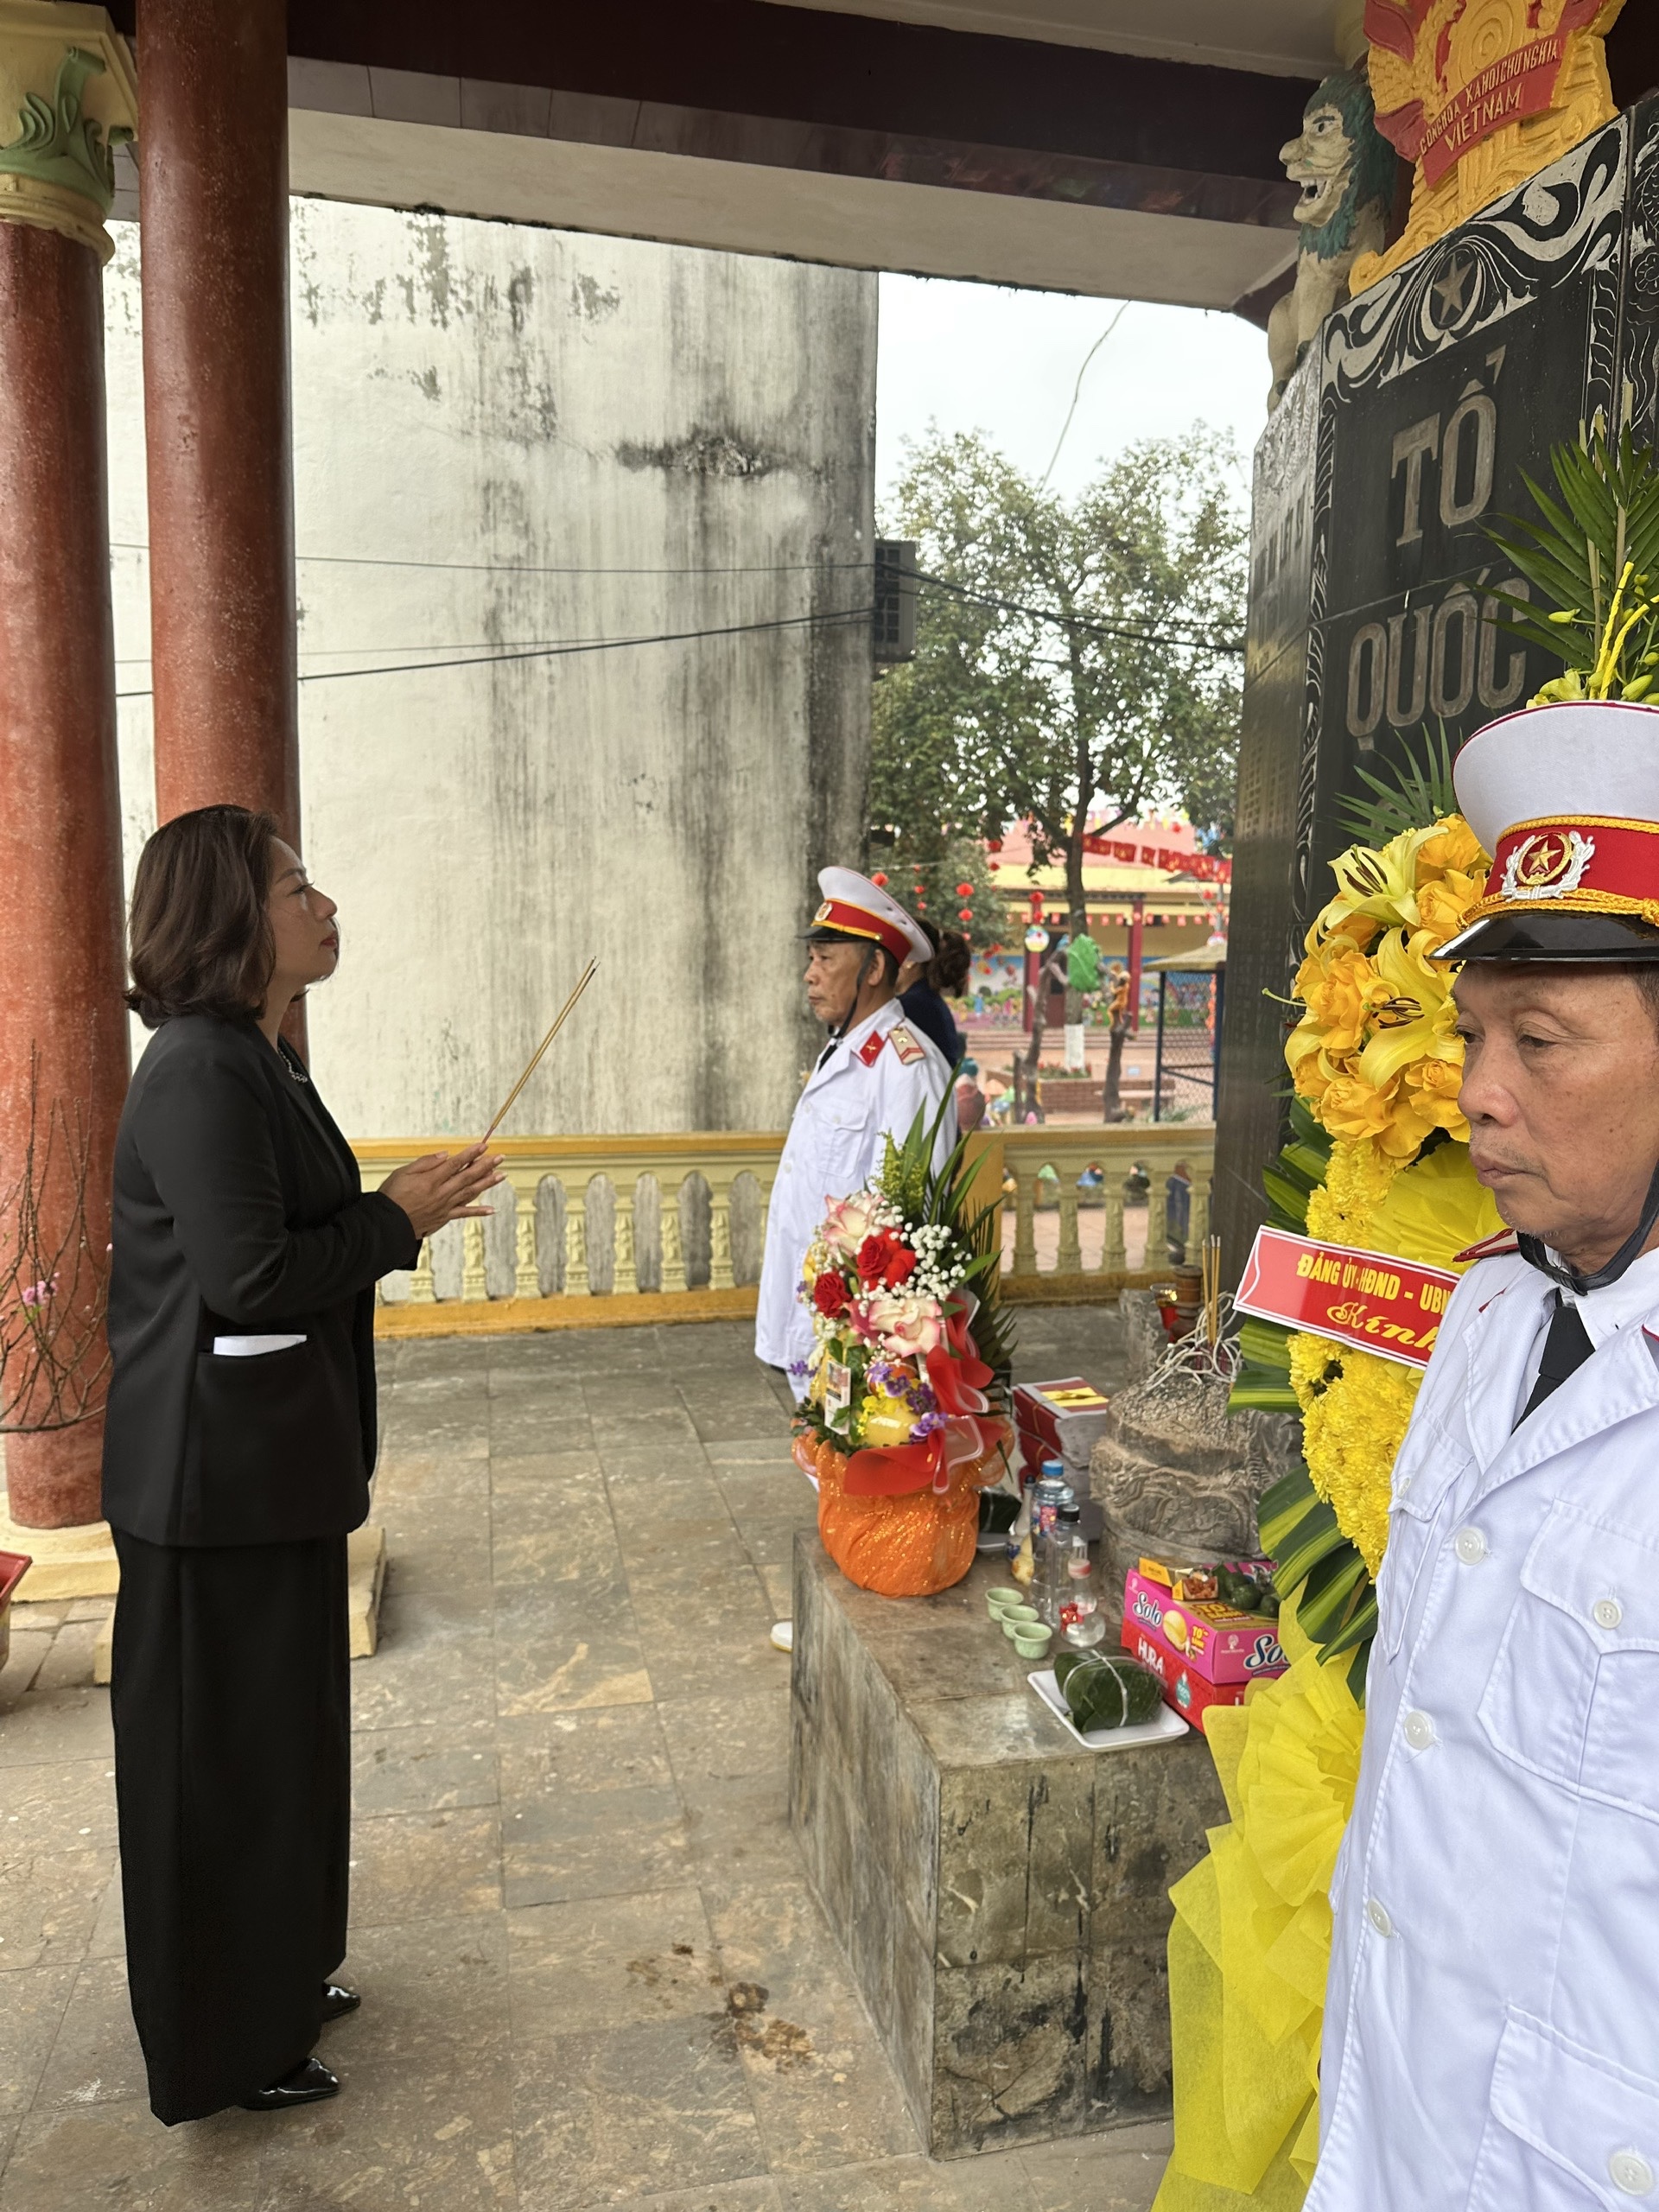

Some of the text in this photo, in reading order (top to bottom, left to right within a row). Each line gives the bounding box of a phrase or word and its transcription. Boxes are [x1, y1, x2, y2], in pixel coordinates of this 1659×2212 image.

[1391, 345, 1505, 547] TỔ
[1346, 568, 1529, 751] QUỐC
[1296, 1252, 1341, 1286] ĐẢNG
[1133, 1591, 1163, 1628] Solo
